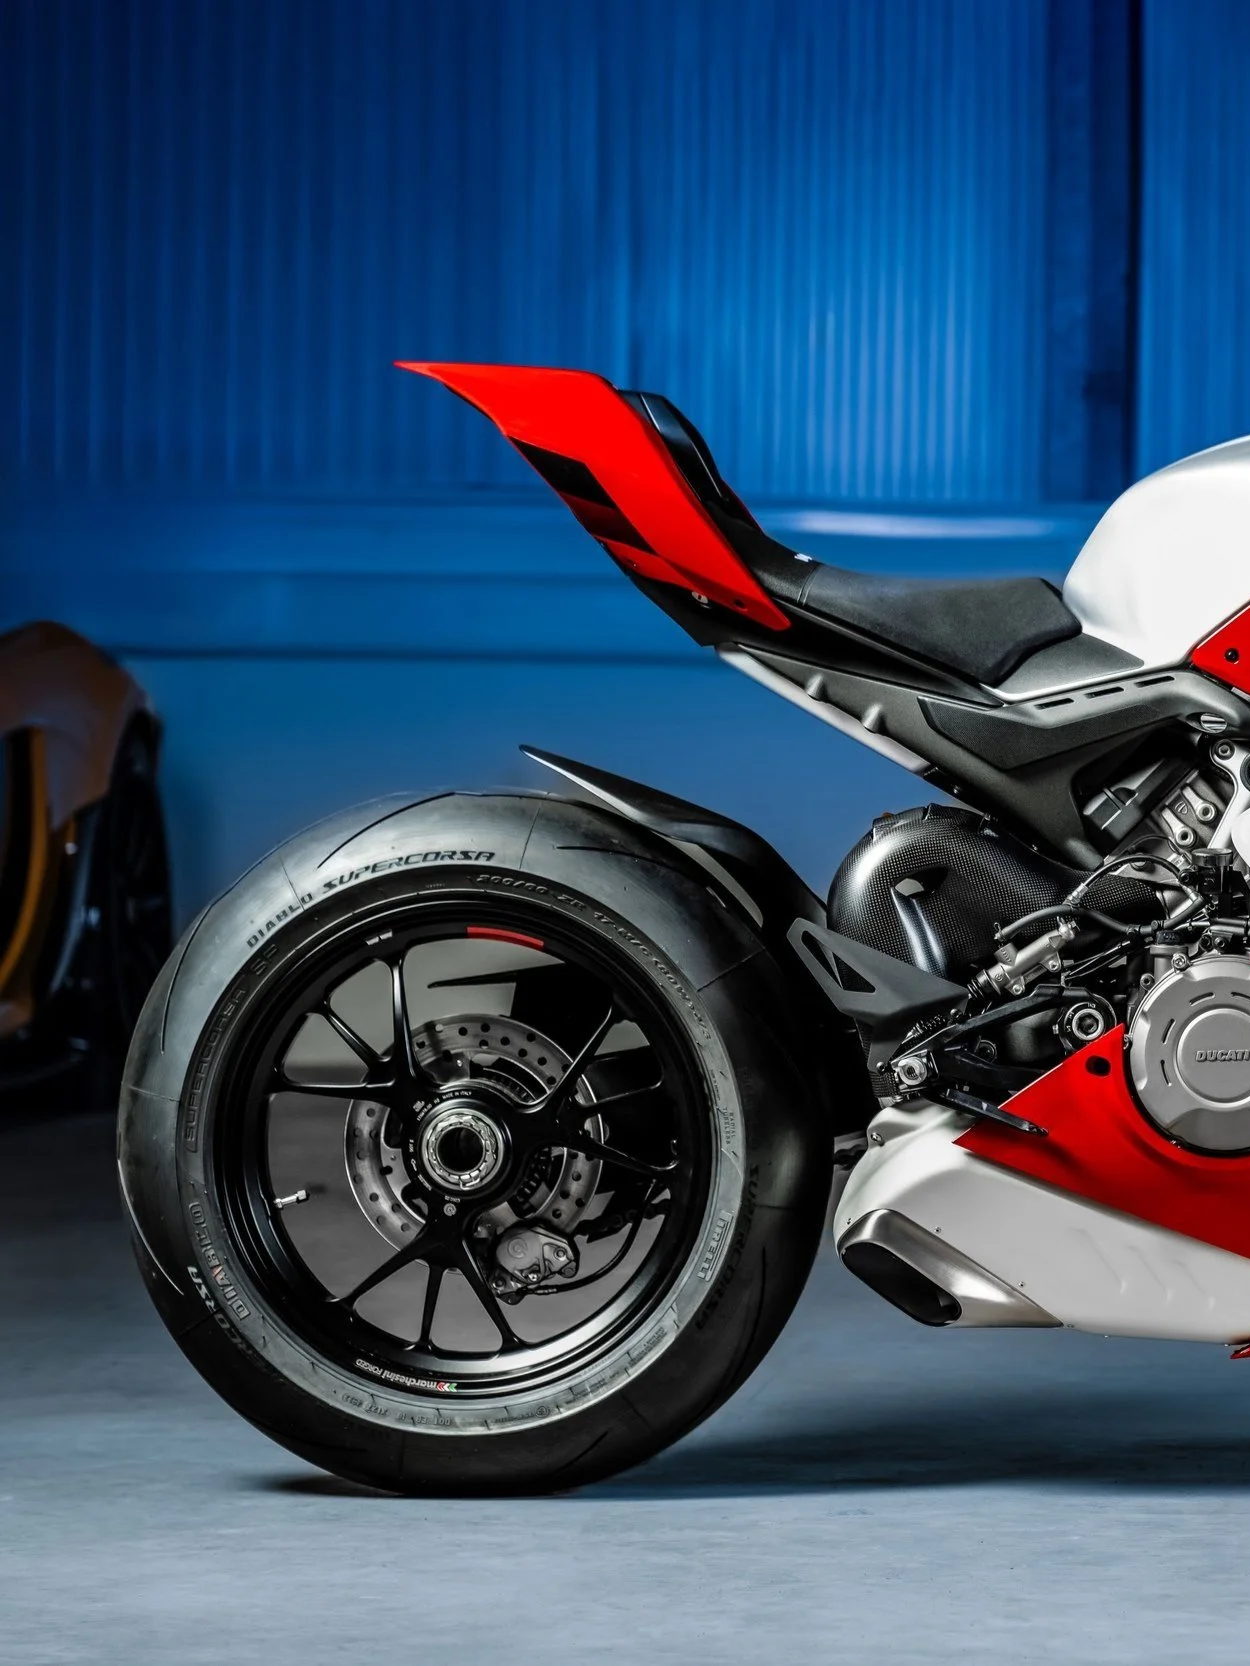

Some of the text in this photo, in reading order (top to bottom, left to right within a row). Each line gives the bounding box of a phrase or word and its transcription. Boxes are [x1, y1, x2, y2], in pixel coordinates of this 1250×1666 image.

[246, 850, 496, 949] DIABLO SUPERCORSA
[183, 989, 247, 1143] SUPERCORSA
[1195, 1050, 1250, 1063] DUCATI
[188, 1201, 251, 1321] DIABLO
[696, 1209, 737, 1283] PIRELLI
[382, 1370, 438, 1389] marchesini
